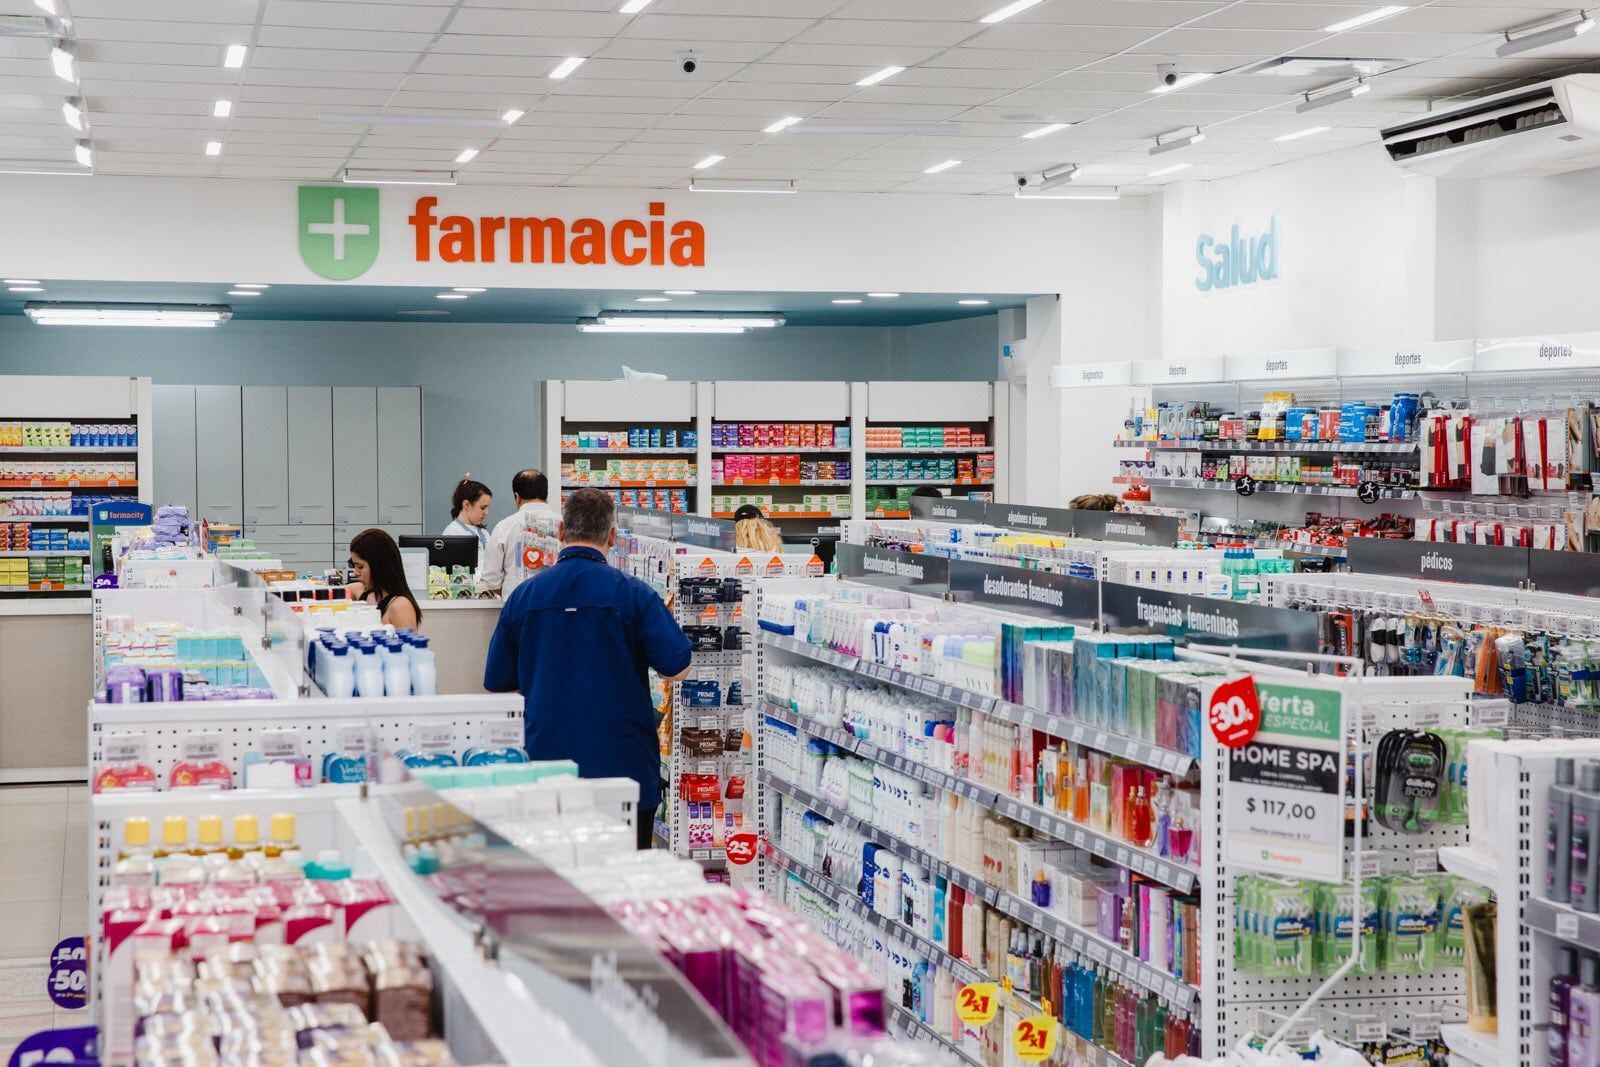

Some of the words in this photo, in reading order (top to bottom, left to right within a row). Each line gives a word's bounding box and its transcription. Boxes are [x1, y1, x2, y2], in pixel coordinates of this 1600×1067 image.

[408, 196, 705, 267] farmacia
[1195, 209, 1280, 292] Salud
[1394, 352, 1421, 369] deportes
[1539, 343, 1572, 360] deportes
[1168, 364, 1187, 377] deportes
[1265, 359, 1288, 374] deportes
[109, 511, 144, 520] farmacity
[863, 553, 895, 574] desodorantes
[896, 557, 924, 580] femeninos
[1420, 552, 1453, 573] pédicos
[983, 574, 1028, 599] desodorantes
[1028, 579, 1064, 608] femeninos
[1137, 596, 1182, 627] fragancias
[1186, 604, 1239, 638] femeninas
[1258, 690, 1315, 716] ferta
[1264, 714, 1331, 734] ESPECIAL
[1232, 746, 1291, 767] HOME
[1296, 753, 1337, 774] SPA
[1405, 787, 1434, 797] BODY
[1246, 797, 1256, 812] $
[1262, 799, 1316, 820] 117,00
[961, 988, 990, 1014] 2x1
[1017, 1021, 1048, 1049] 2x1
